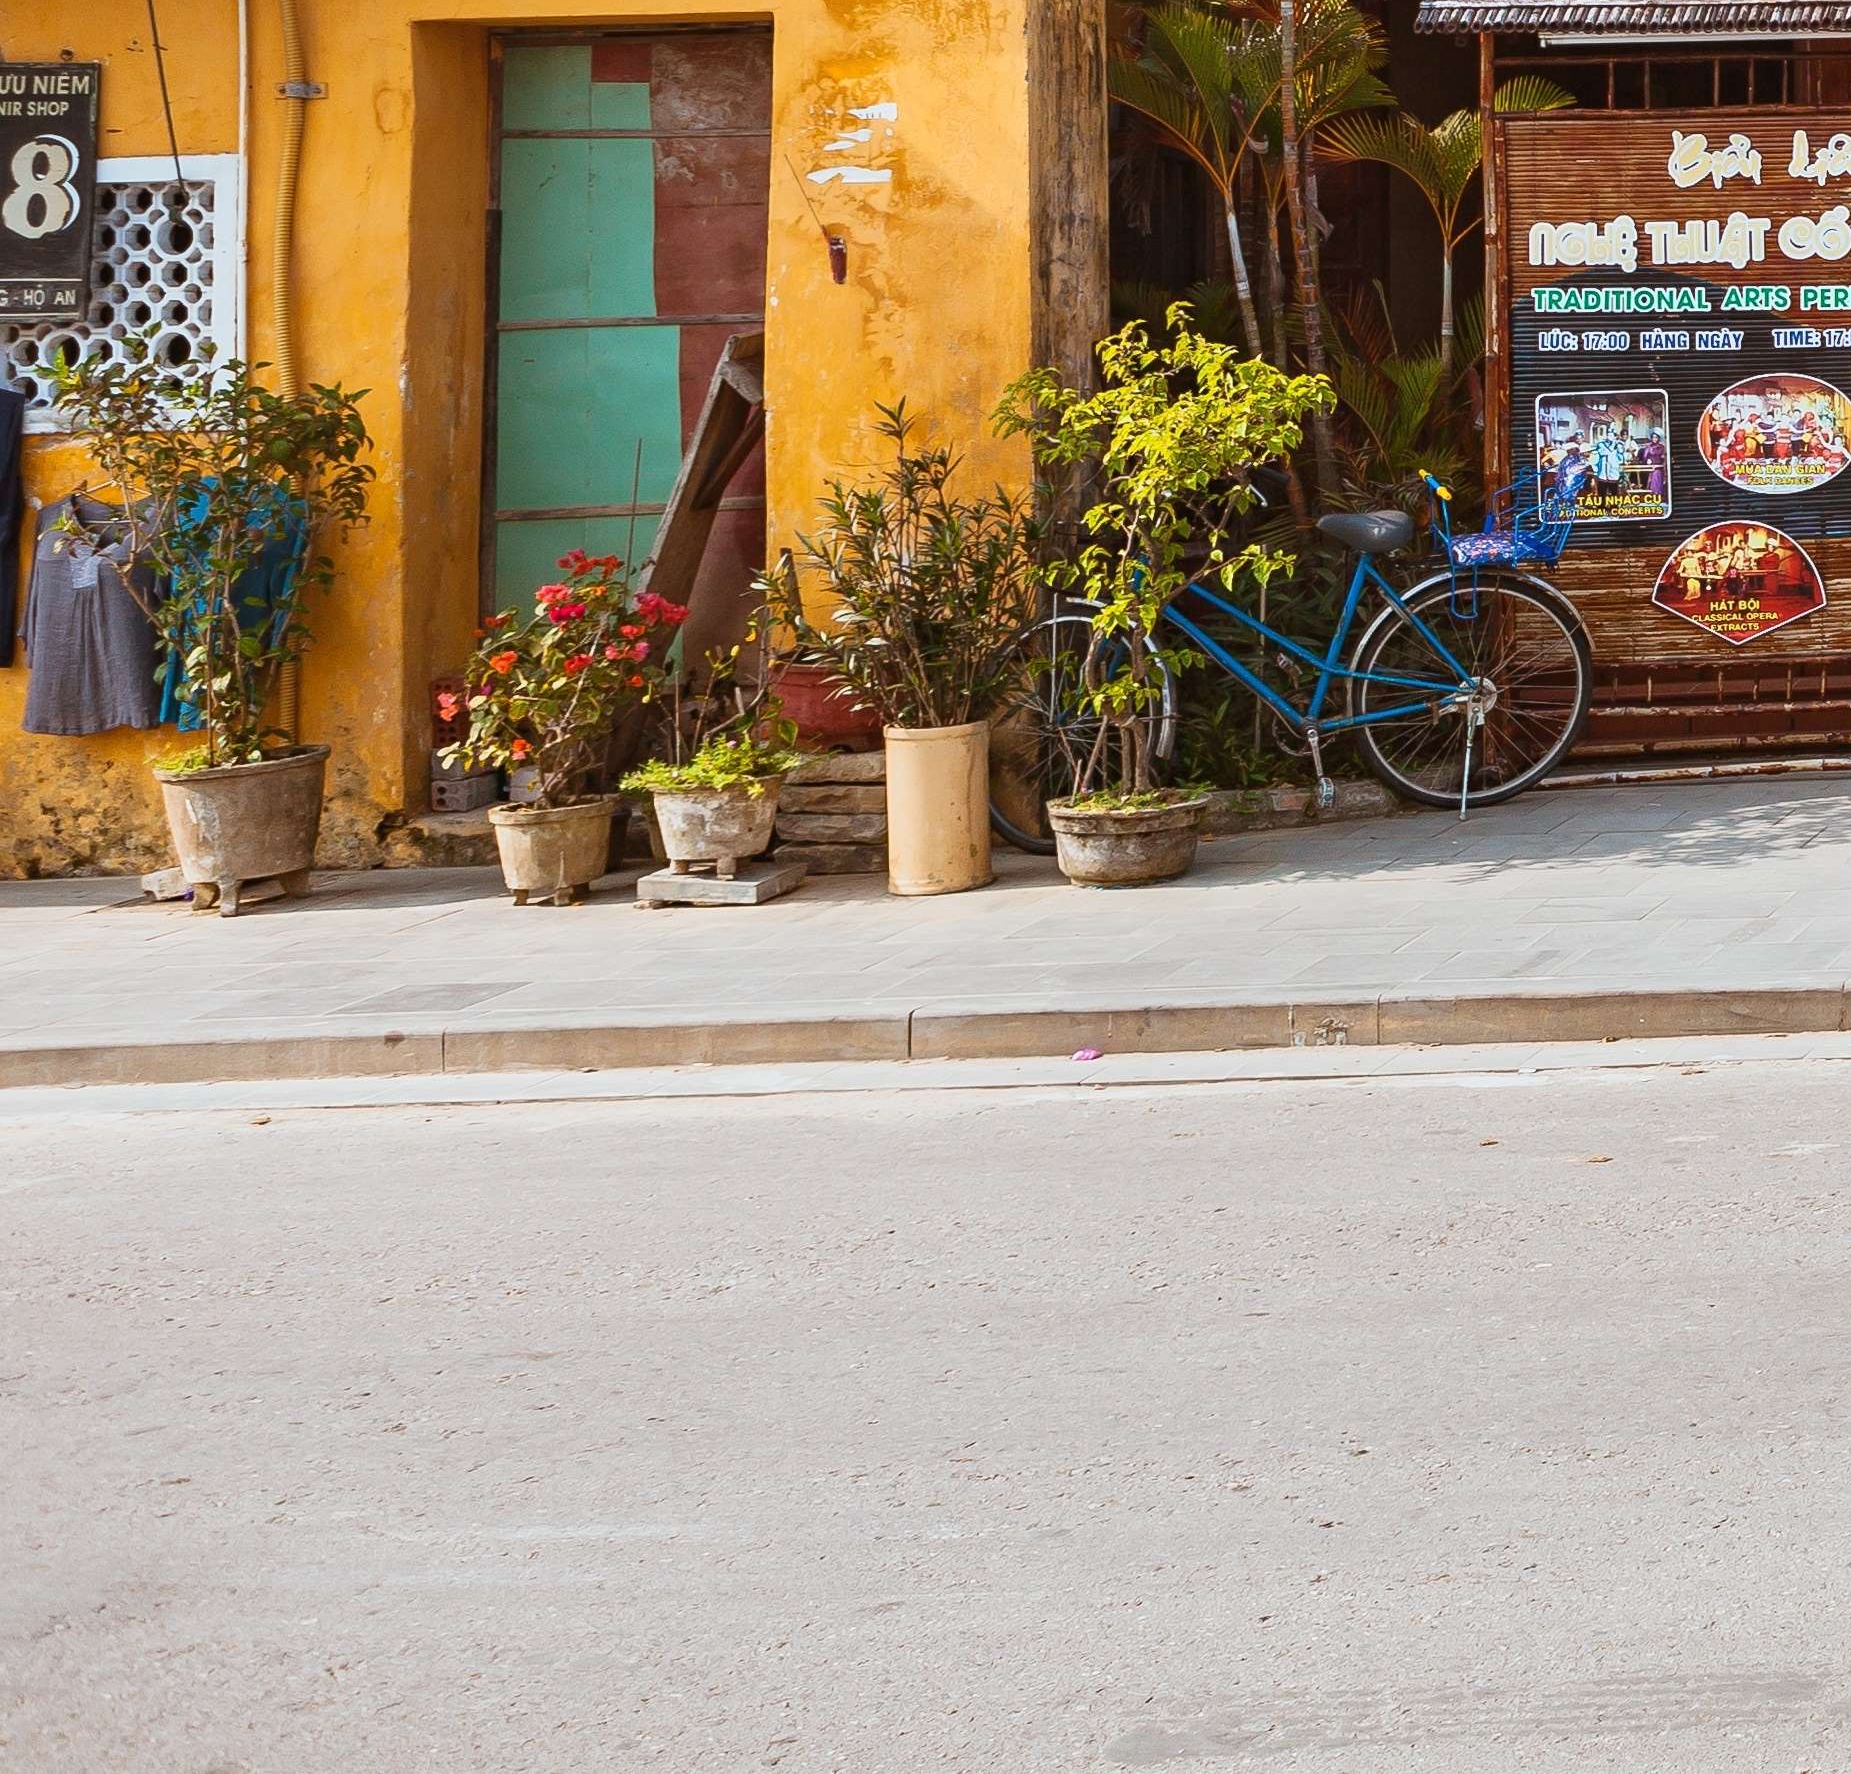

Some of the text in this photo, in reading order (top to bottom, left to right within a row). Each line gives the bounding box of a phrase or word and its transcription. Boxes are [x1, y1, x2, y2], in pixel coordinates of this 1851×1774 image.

[0, 74, 26, 95] ƯU
[27, 101, 70, 116] SHOP
[1645, 211, 1771, 269] THUẬT
[54, 290, 77, 305] AN
[1532, 287, 1711, 312] TRADITIONAL
[1721, 285, 1791, 311] ARTS
[1539, 329, 1578, 351] LÚC:
[1583, 330, 1630, 350] 17:00
[1640, 328, 1689, 349] HÀNG
[1696, 327, 1744, 349] NGÀY
[1772, 328, 1821, 348] TIME:
[1796, 464, 1826, 475] GIAN
[1747, 476, 1814, 485] FOLK DANCES
[1611, 506, 1663, 517] CONCERTS
[1710, 599, 1735, 611] HÁT
[1691, 612, 1778, 622] CLASSICAL OPERA
[1710, 623, 1760, 632] EXTRACTS
